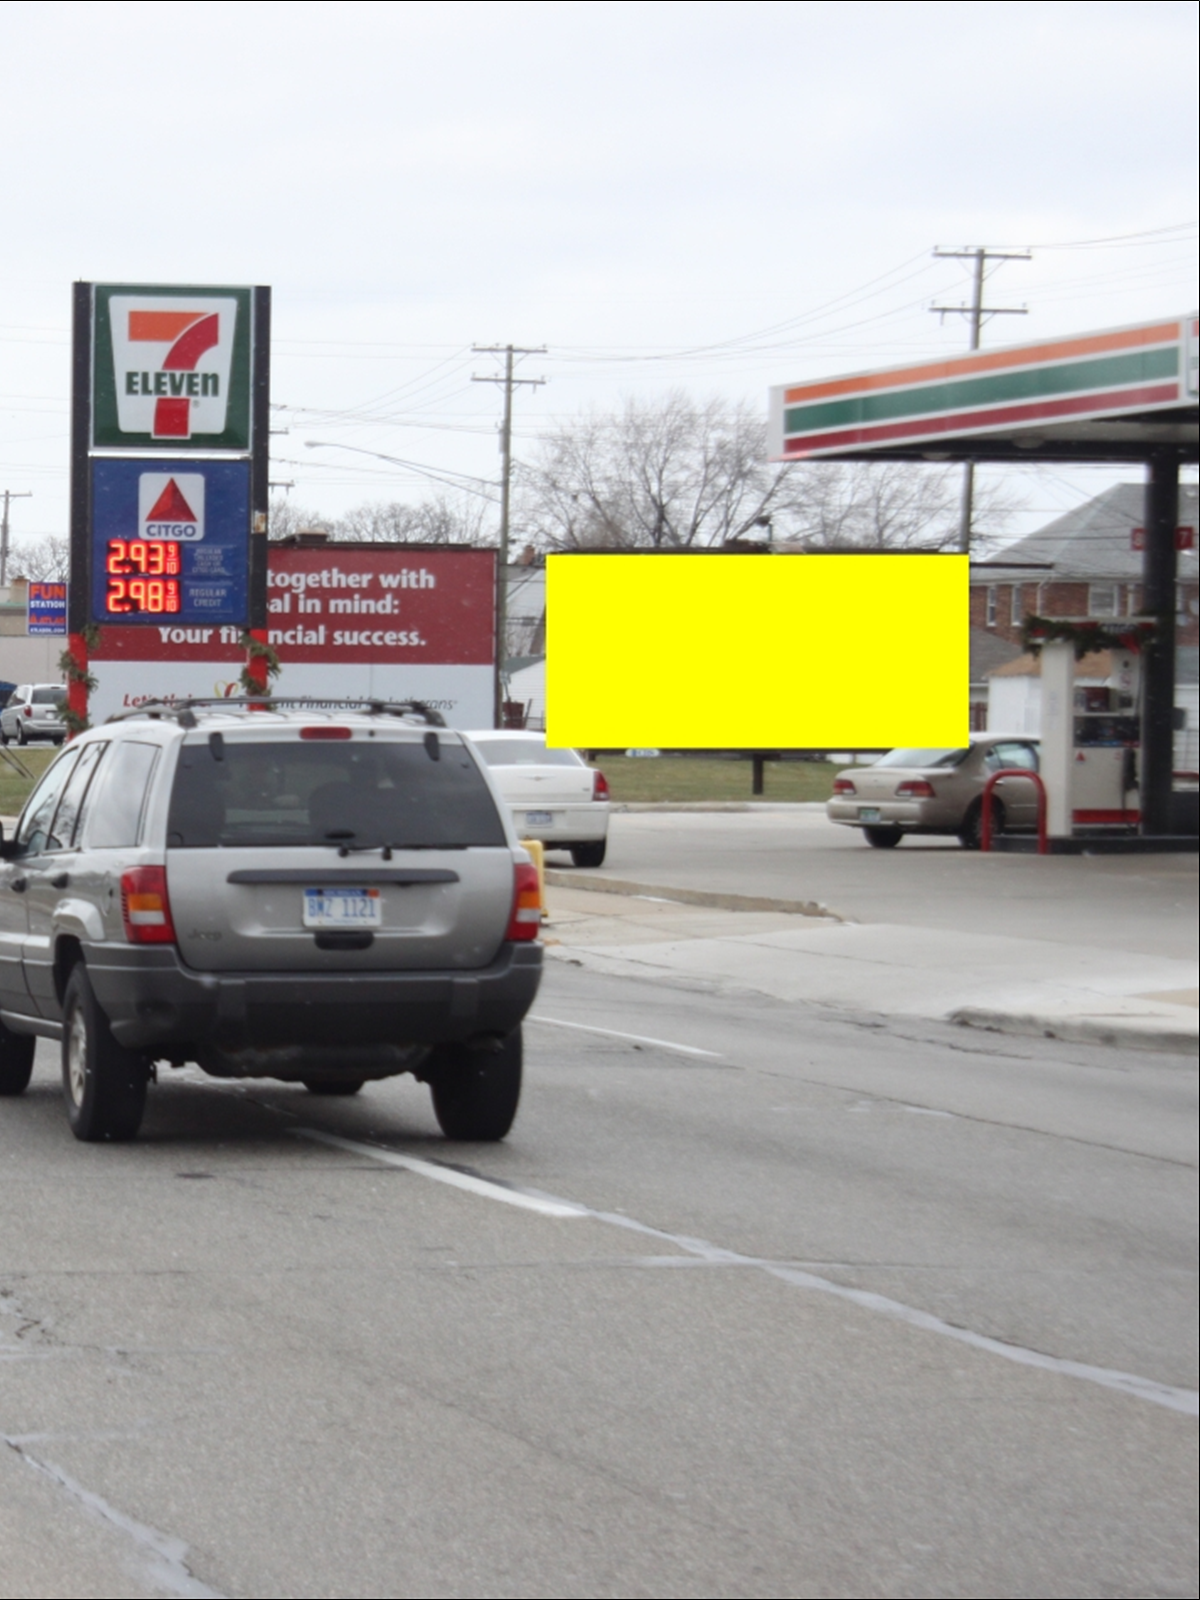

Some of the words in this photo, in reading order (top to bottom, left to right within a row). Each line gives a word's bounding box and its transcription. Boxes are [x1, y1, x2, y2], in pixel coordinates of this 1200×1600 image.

[128, 311, 220, 437] 7
[146, 524, 197, 538] CITGO
[108, 543, 164, 575] 2.93
[266, 567, 373, 594] together
[378, 568, 435, 588] with
[30, 584, 65, 600] FUN
[108, 581, 164, 612] 2.98
[189, 588, 227, 598] REGULAR
[30, 600, 65, 609] STATION
[193, 598, 222, 608] CREDIT
[266, 592, 291, 614] al
[298, 593, 321, 614] in
[328, 593, 400, 615] mind:
[158, 626, 214, 644] Your
[219, 625, 326, 646] fincial
[332, 629, 427, 647] success.
[342, 898, 376, 918] 1121
